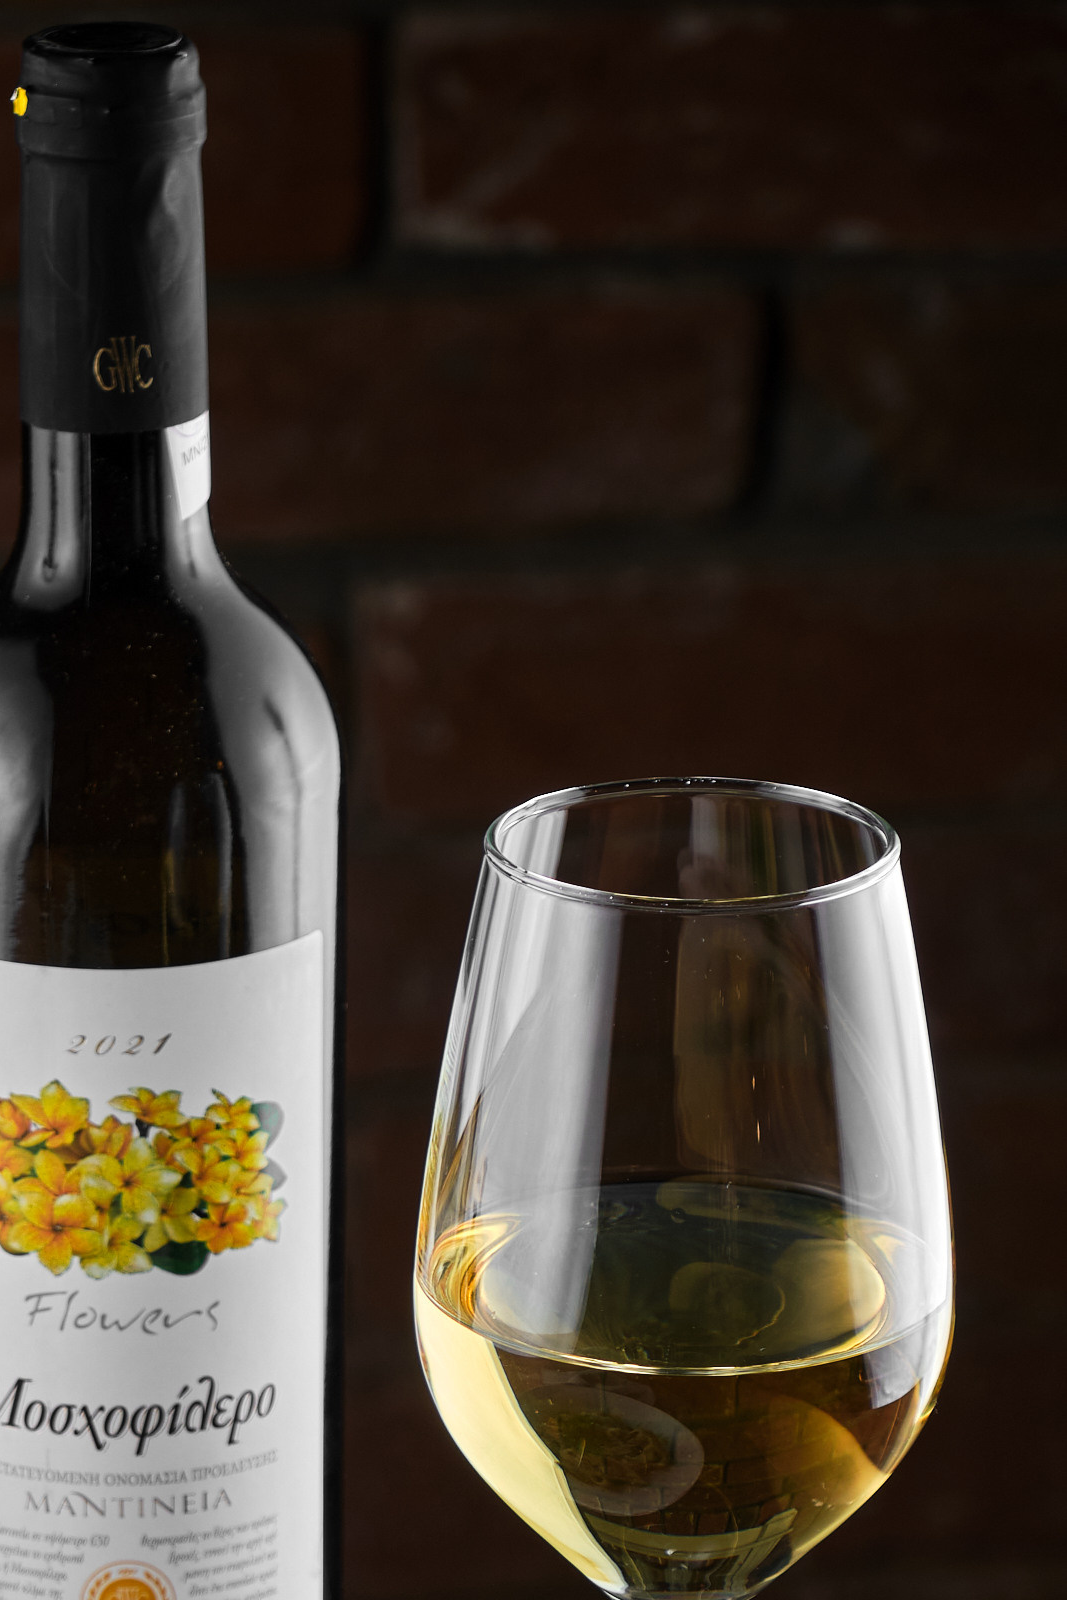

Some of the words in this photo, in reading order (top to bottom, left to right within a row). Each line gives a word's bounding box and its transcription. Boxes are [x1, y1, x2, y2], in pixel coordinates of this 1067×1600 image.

[93, 336, 153, 392] GWC
[66, 1033, 174, 1056] 2021
[24, 1289, 220, 1336] Flowers
[104, 1470, 187, 1486] ΟΝΟΜΑΣΙΑ
[25, 1488, 232, 1518] ΜΑΝΤΙΝΕΙΑ
